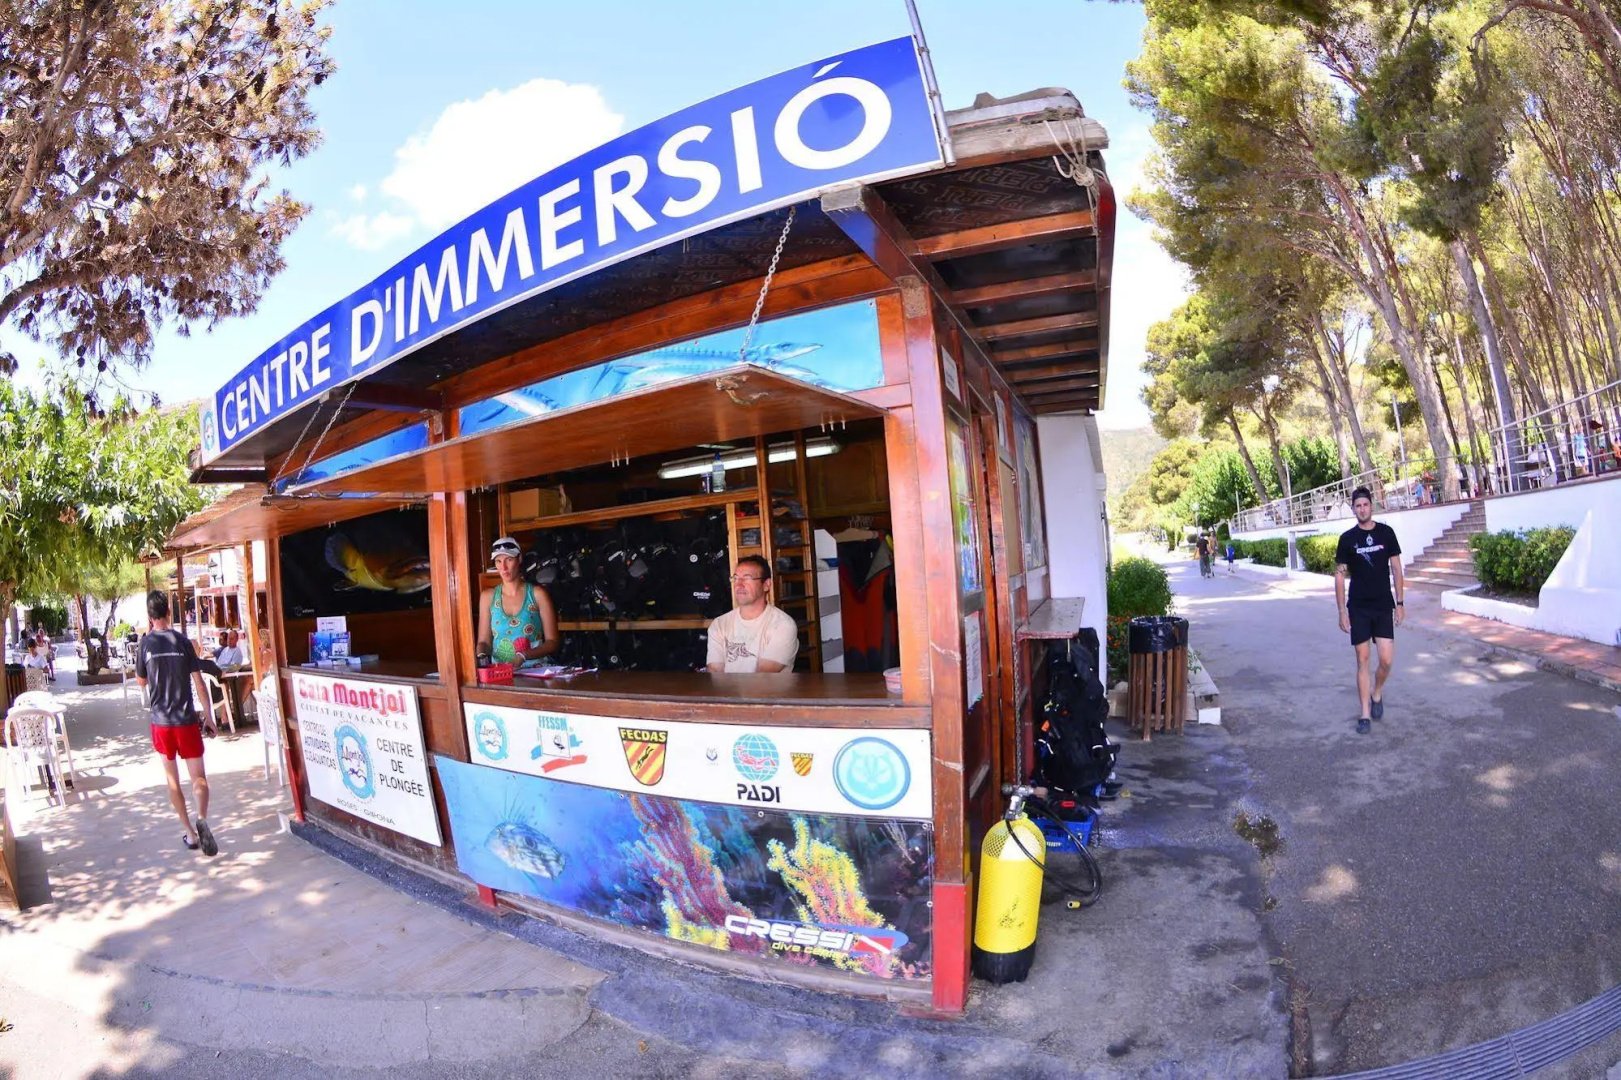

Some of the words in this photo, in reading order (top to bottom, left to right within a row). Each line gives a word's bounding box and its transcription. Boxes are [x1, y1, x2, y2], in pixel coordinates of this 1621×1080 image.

[221, 322, 331, 440] CENTRE
[350, 60, 892, 365] D'IMMERSIÓ
[333, 682, 407, 716] Montjoi
[333, 710, 345, 719] DE
[348, 711, 409, 731] VACANCES
[538, 715, 568, 731] FFESSM
[620, 728, 667, 743] FECDAS
[376, 738, 414, 758] CENTRE
[391, 759, 404, 774] DE
[379, 773, 425, 797] PLONGÉE
[737, 783, 780, 803] PADI
[724, 914, 854, 951] CRESSI
[771, 941, 801, 953] dive
